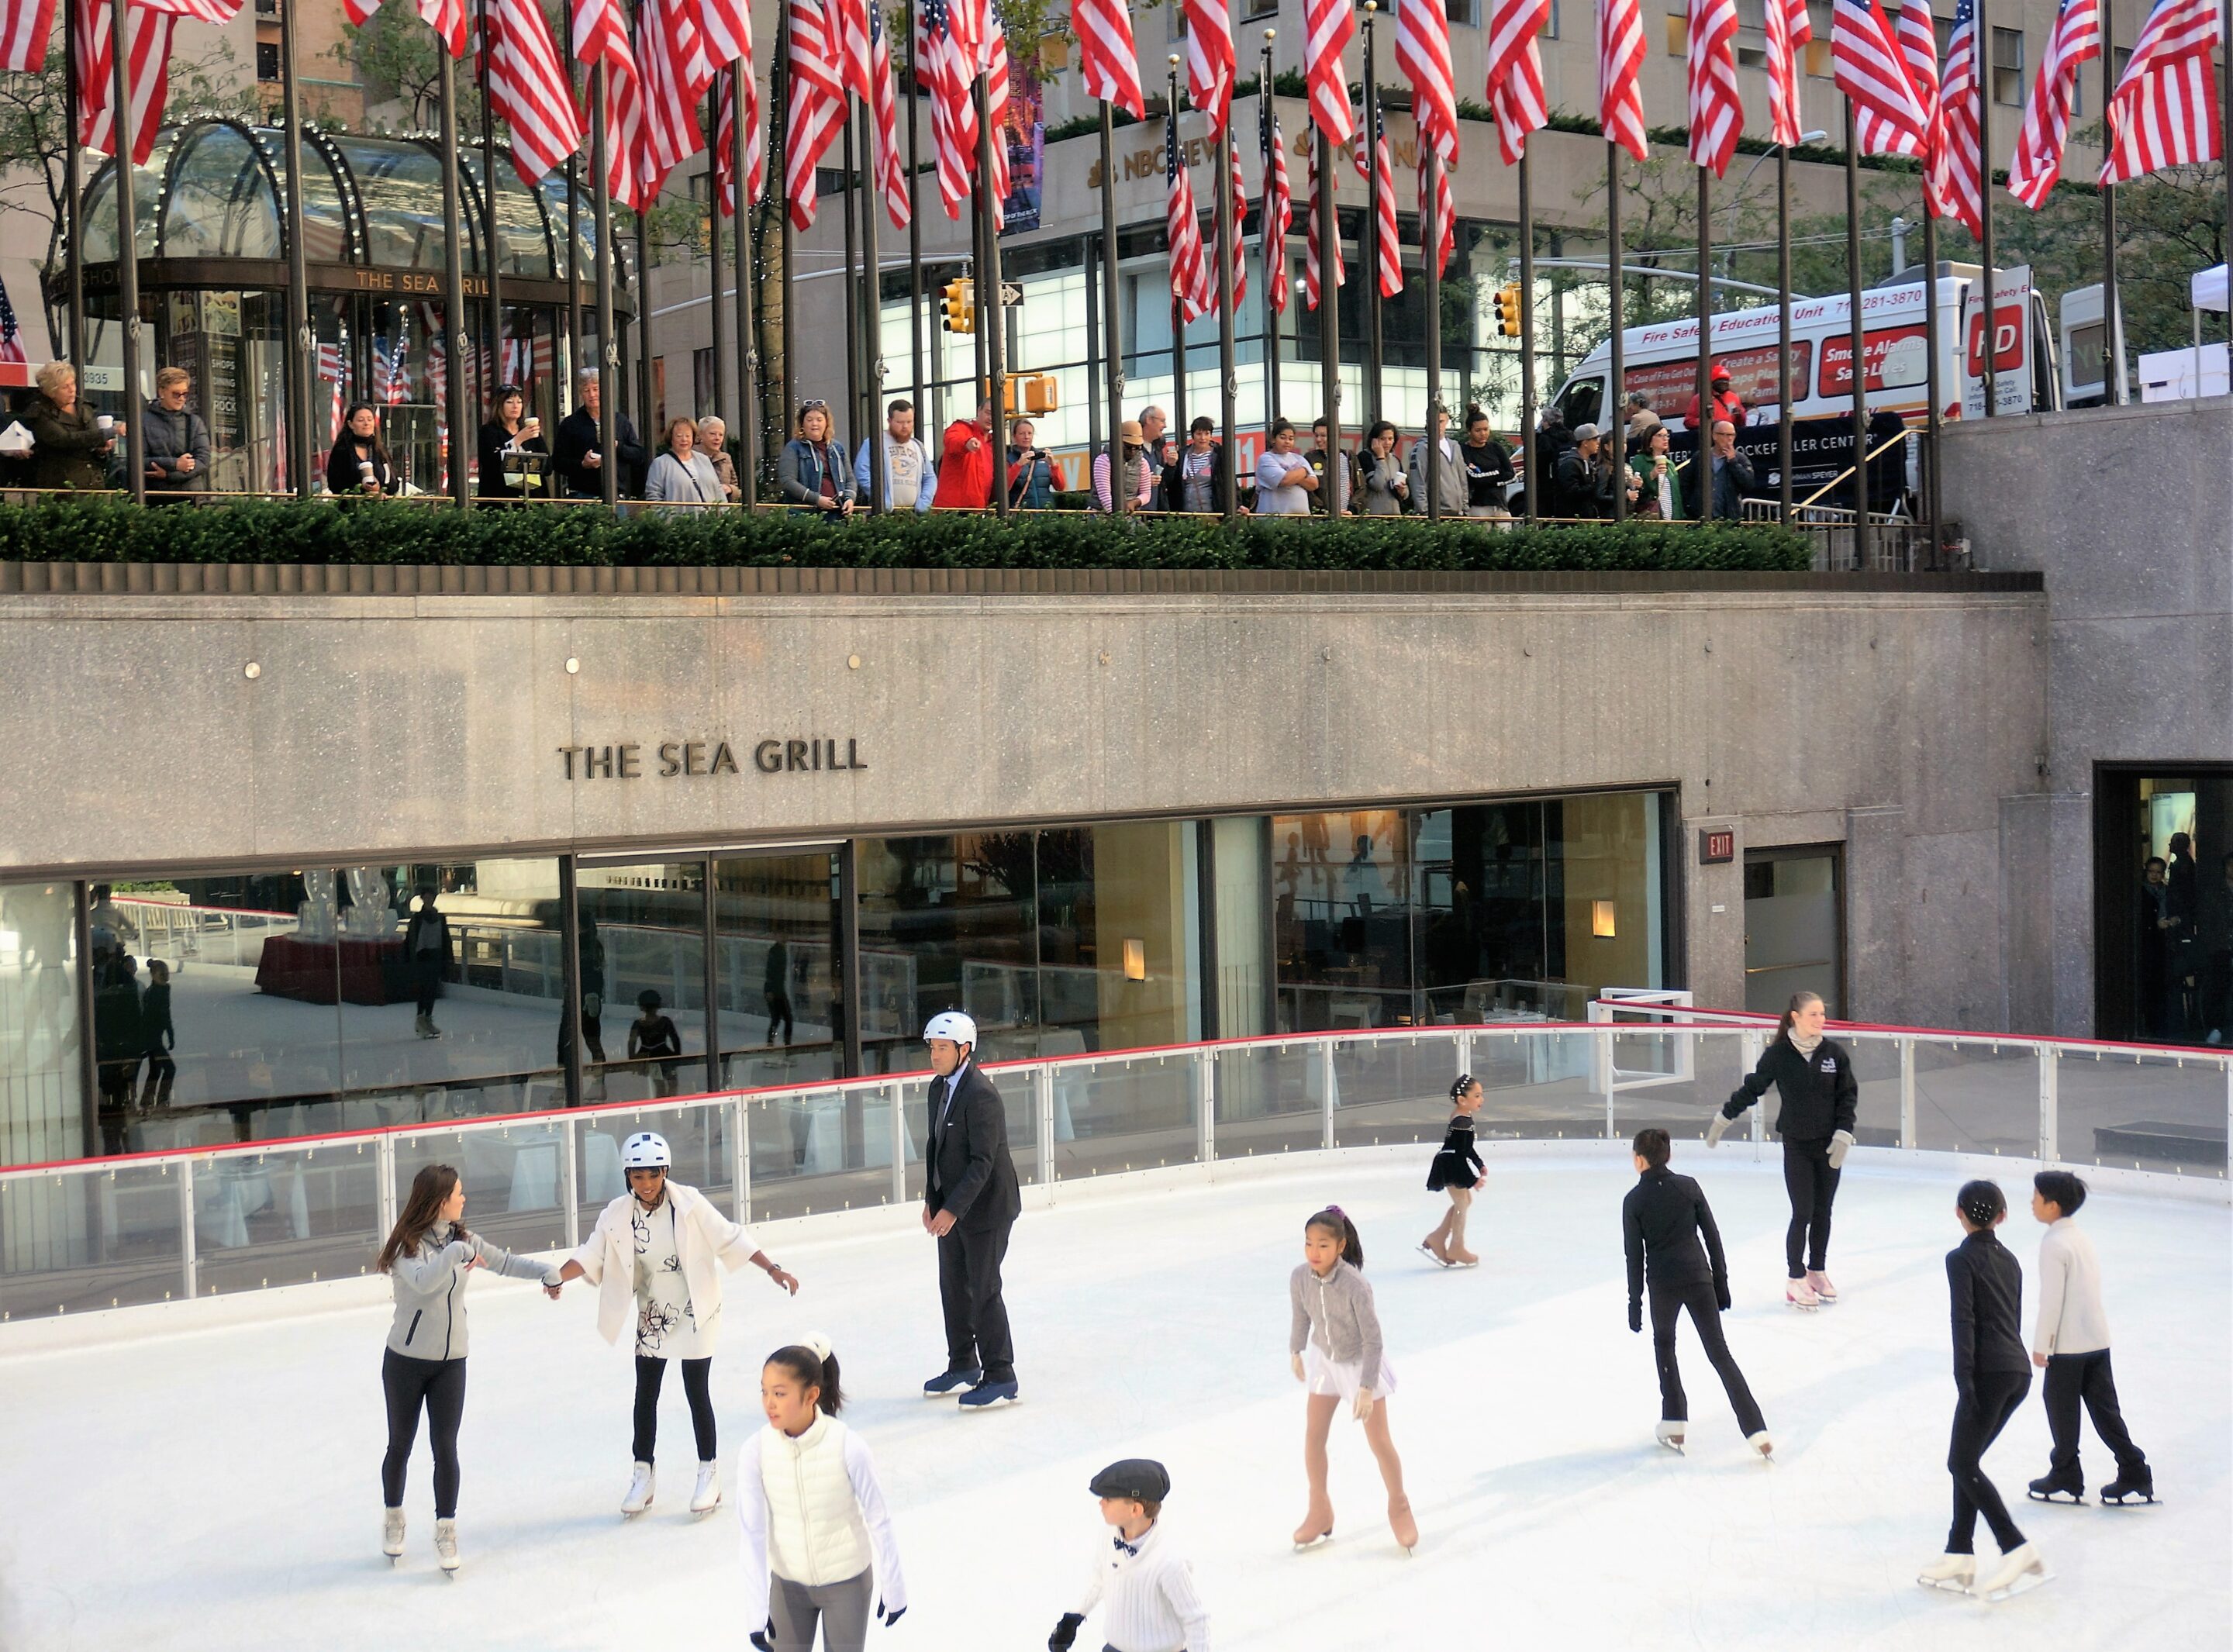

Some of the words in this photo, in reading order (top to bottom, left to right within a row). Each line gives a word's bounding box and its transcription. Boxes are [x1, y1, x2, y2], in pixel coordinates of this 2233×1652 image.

[1124, 145, 1166, 181] NBC
[356, 271, 393, 288] THE
[402, 274, 440, 291] SEA
[462, 278, 490, 295] RIL
[1994, 288, 2017, 298] afety
[1642, 333, 1667, 343] Fire
[1672, 324, 1715, 339] Safey
[1718, 313, 1780, 332] Educatio
[1794, 305, 1824, 319] Unit
[1835, 290, 1922, 313] 71281-3870
[1825, 345, 1872, 362] Smoe
[1835, 365, 1869, 381] Sae
[1969, 394, 2023, 412] 718-1-3870
[1735, 438, 1817, 457] OCKEFLER
[1821, 434, 1873, 450] CENTR
[556, 744, 642, 781] THE
[659, 742, 740, 778] SEA
[754, 738, 868, 774] GRILL
[1710, 835, 1731, 856] EXIT
